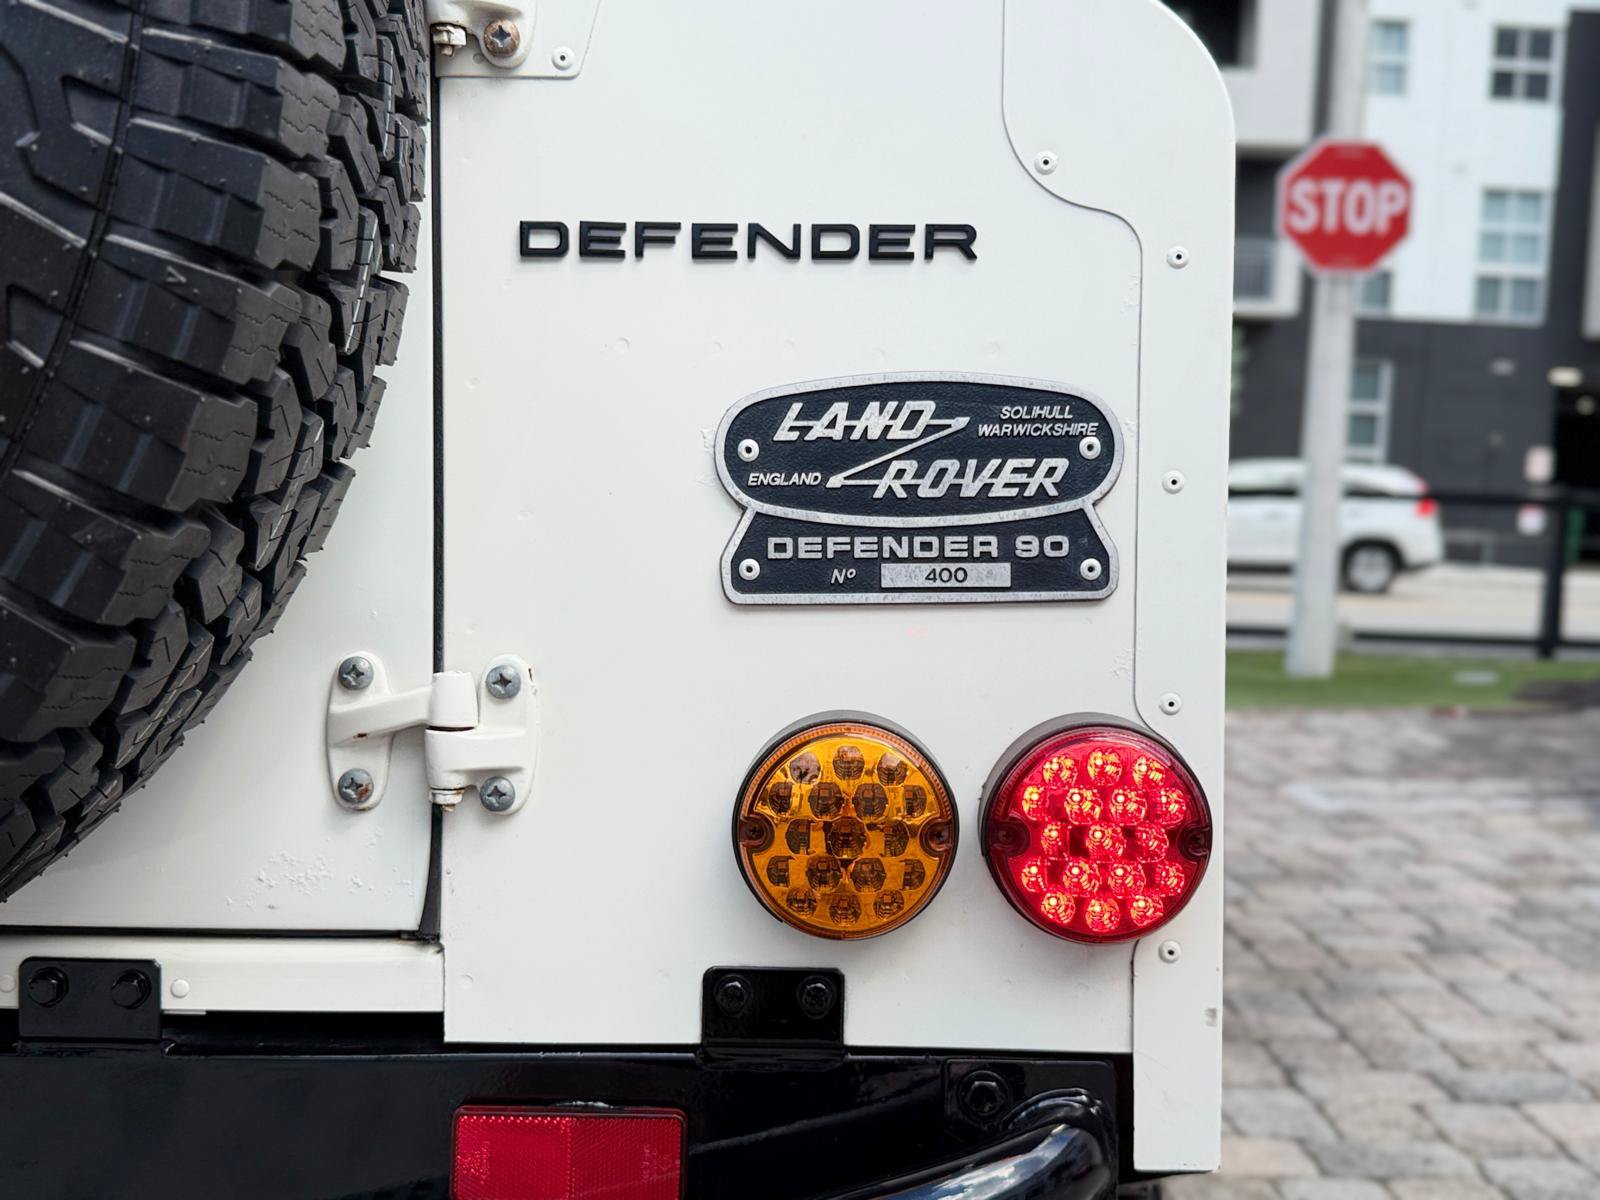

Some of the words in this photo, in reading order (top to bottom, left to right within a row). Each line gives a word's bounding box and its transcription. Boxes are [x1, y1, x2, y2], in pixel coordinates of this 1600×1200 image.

[1288, 178, 1408, 235] STOP
[519, 220, 978, 261] DEFENDER
[773, 400, 937, 442] LAND
[1000, 406, 1073, 420] SOLIHULL
[977, 422, 1099, 437] WARWICKSHIRE
[747, 471, 822, 487] ENGLAND
[872, 457, 1071, 499] ROVER
[766, 535, 999, 560] DEFENDER
[1014, 534, 1071, 559] 90
[924, 566, 968, 584] 400
